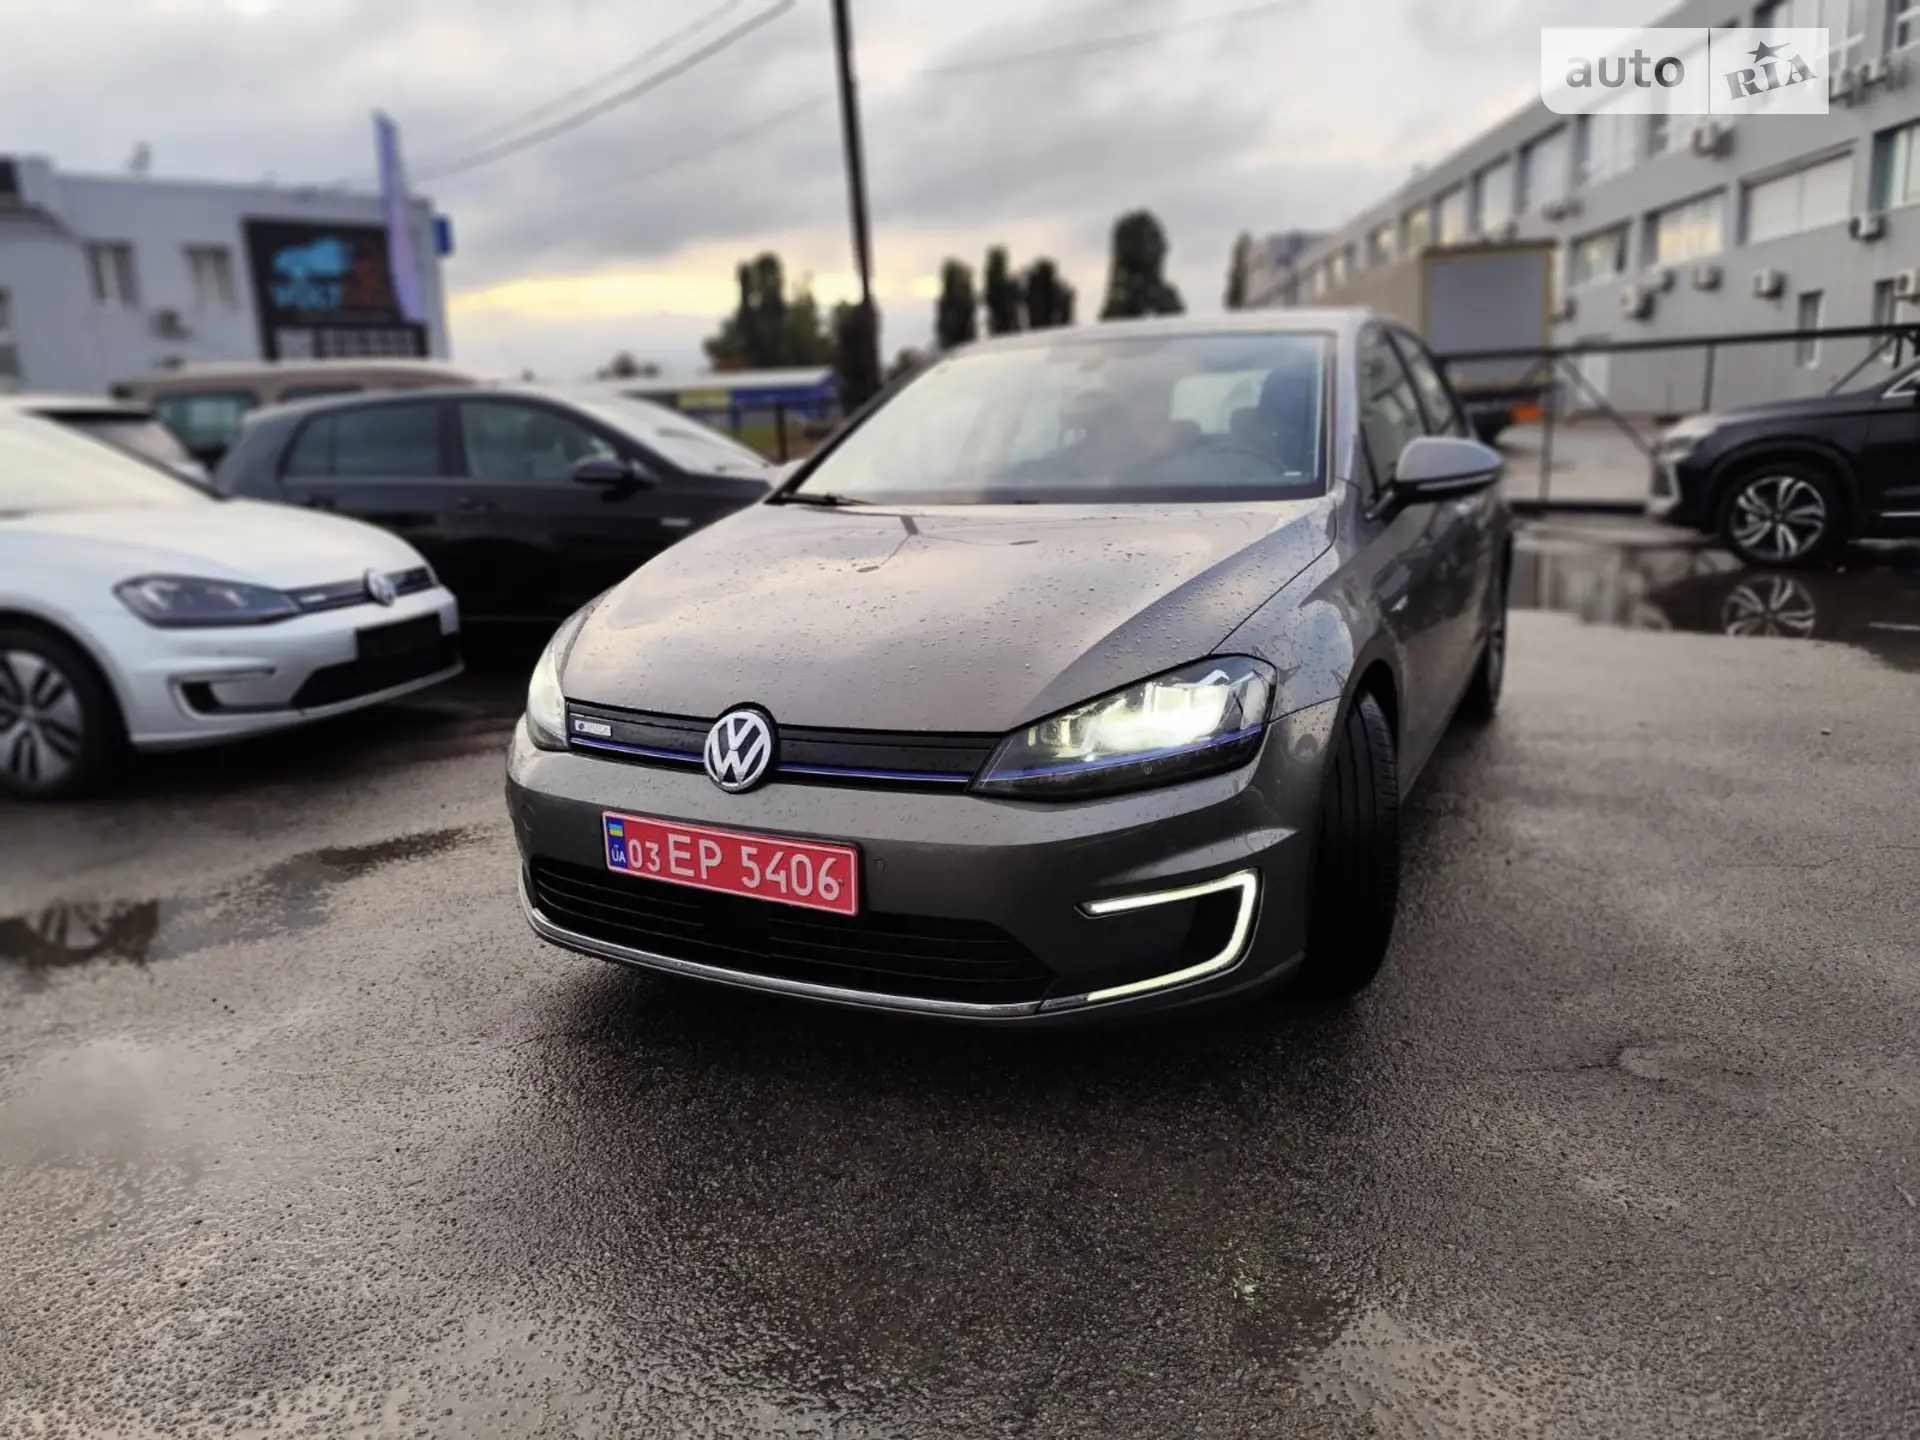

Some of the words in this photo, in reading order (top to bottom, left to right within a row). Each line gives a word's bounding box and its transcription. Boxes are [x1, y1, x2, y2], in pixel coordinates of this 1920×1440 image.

[706, 712, 770, 786] VW
[611, 845, 626, 864] UA
[740, 845, 841, 901] 5406
